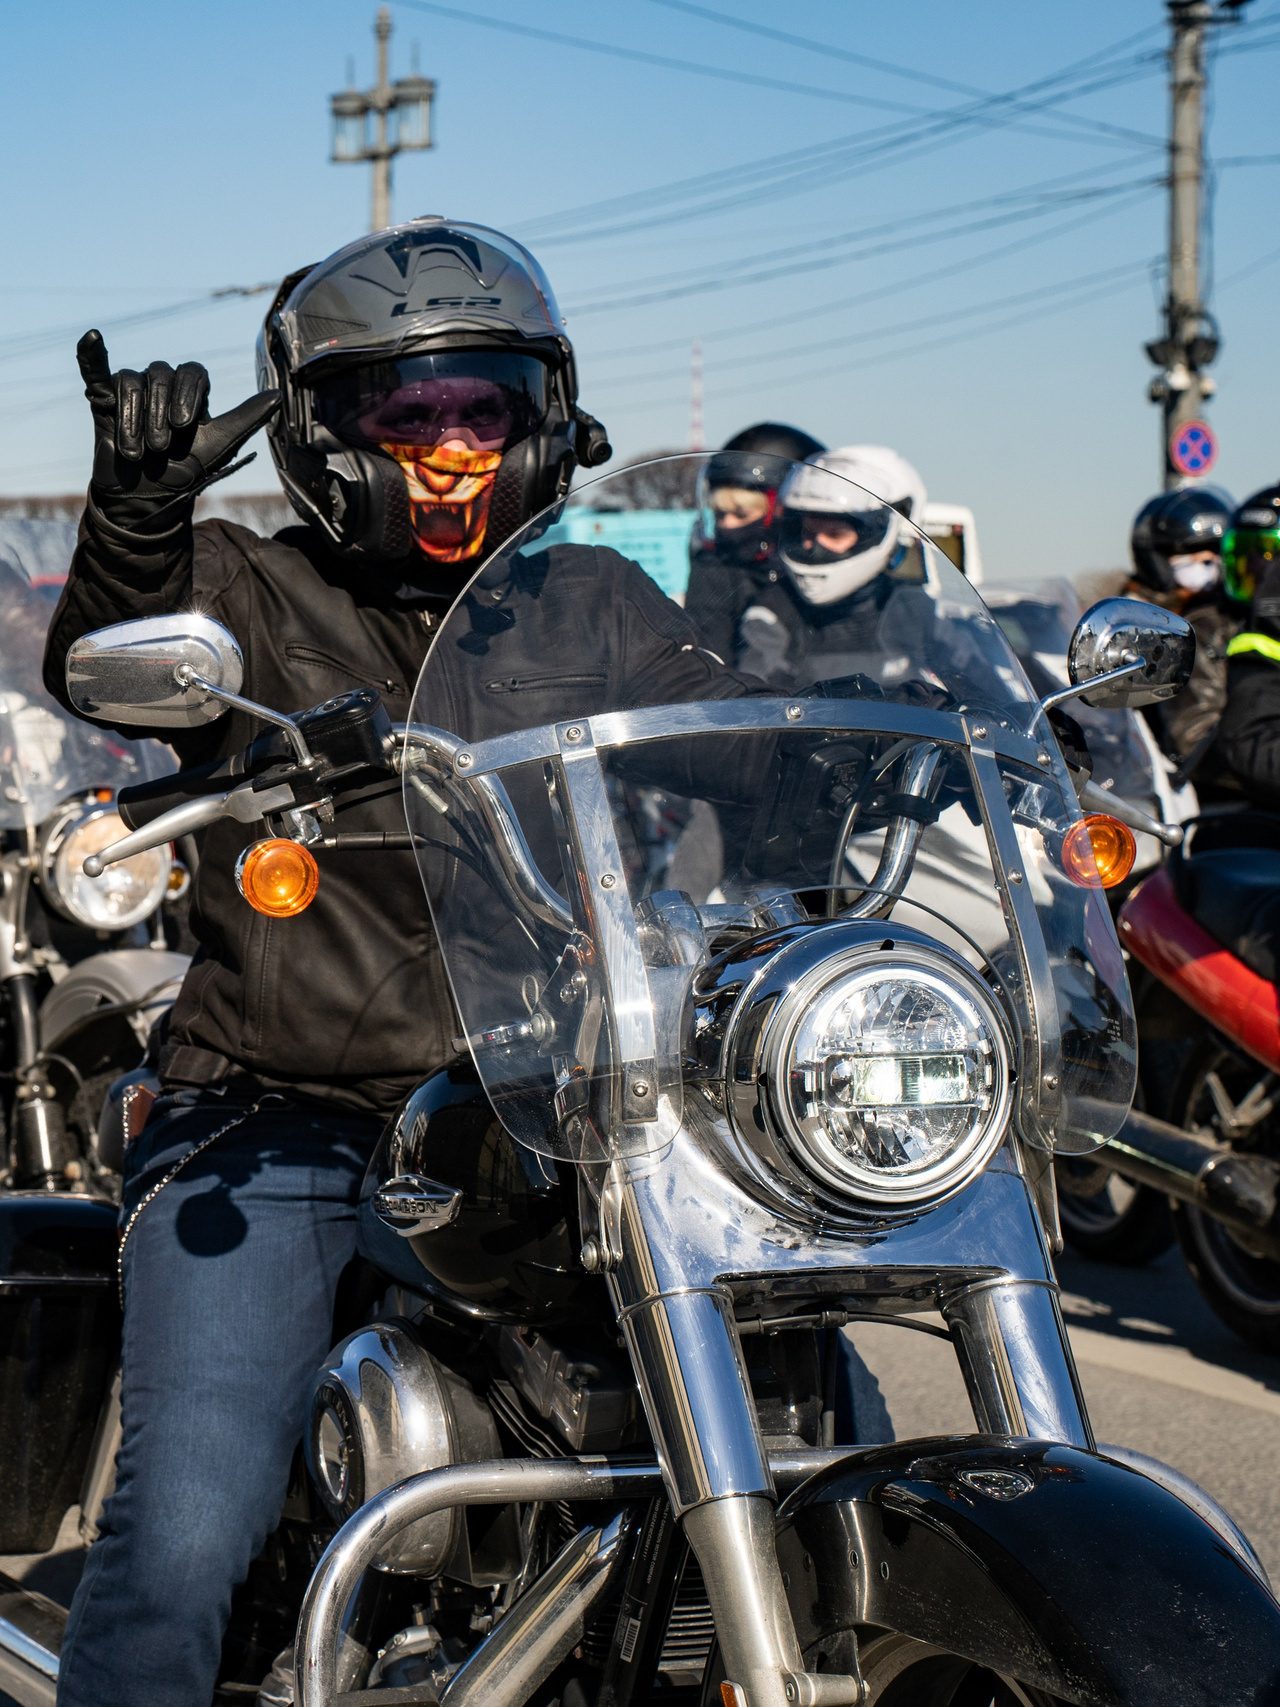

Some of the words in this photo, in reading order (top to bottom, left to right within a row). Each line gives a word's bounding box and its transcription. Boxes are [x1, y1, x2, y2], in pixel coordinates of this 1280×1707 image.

[391, 297, 501, 316] LS2
[652, 1543, 660, 1561] MOTOR
[647, 1561, 655, 1584] COMPANY
